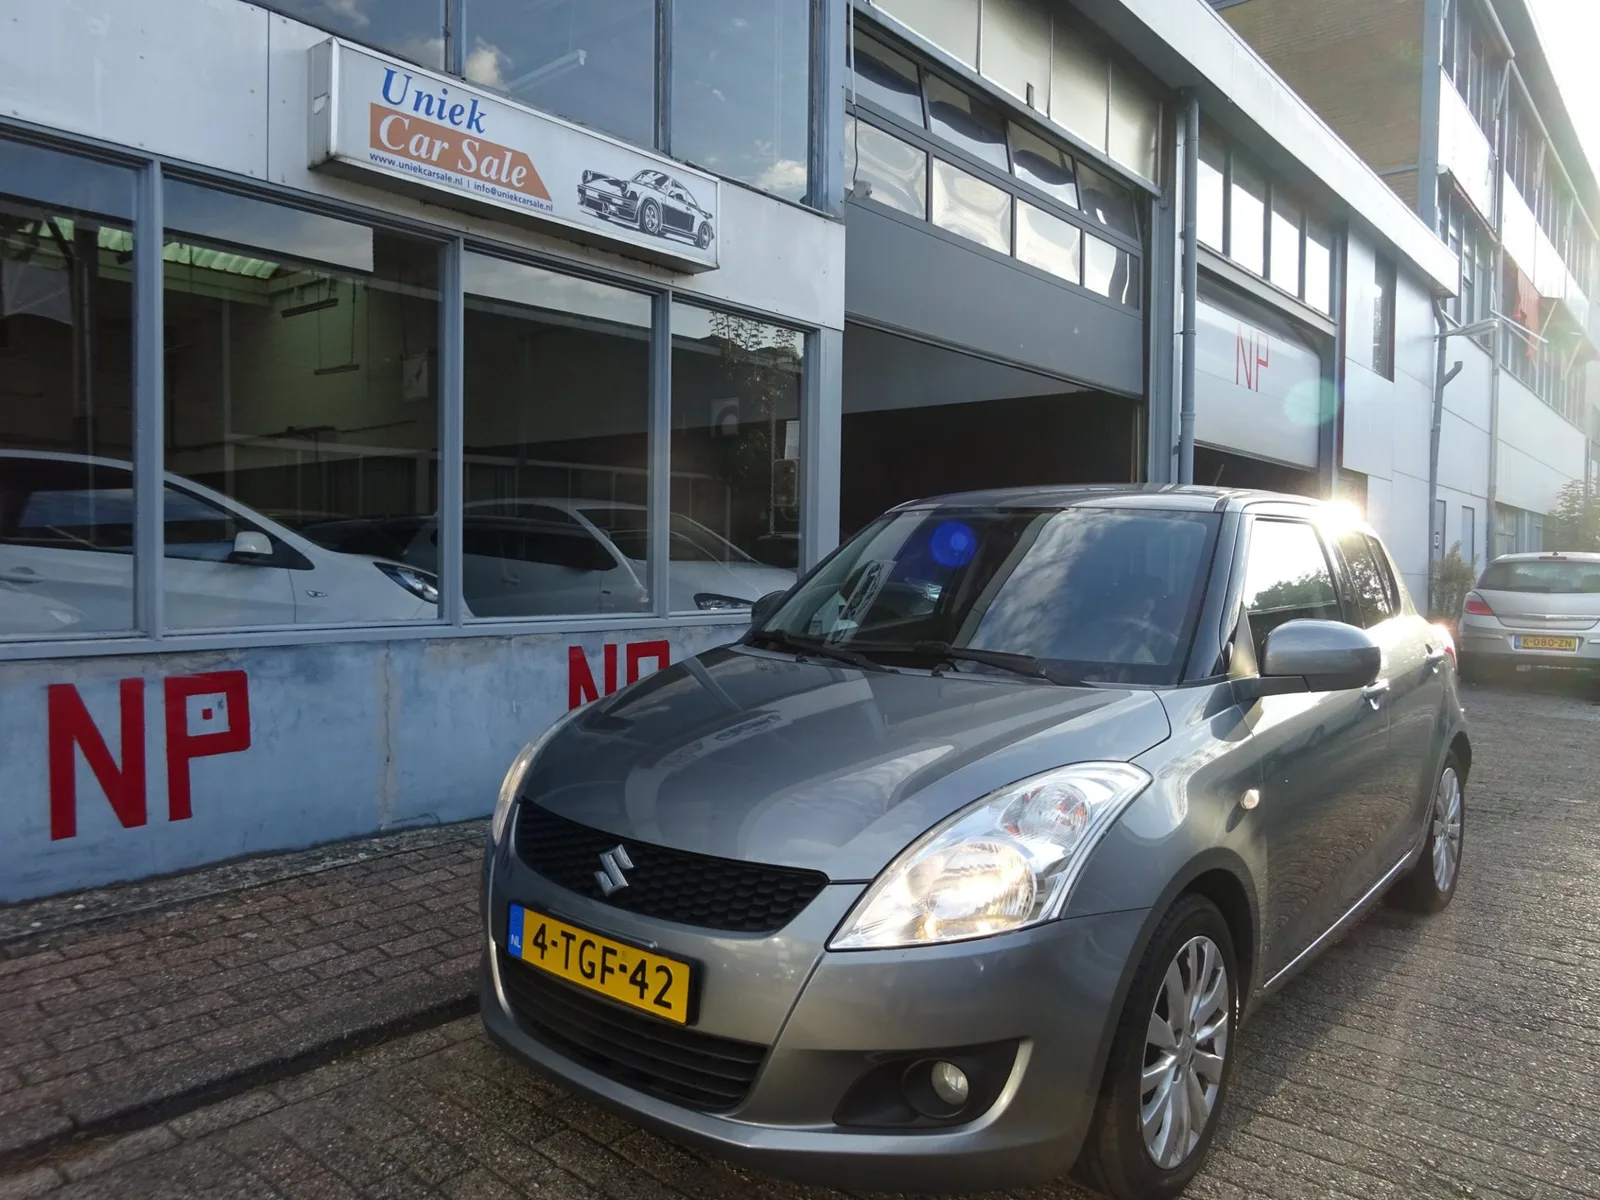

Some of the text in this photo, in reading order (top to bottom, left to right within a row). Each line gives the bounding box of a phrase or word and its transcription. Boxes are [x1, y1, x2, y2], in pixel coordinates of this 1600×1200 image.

[382, 67, 487, 134] Uniek
[369, 152, 554, 212] www.uniekcarsale.nl info@uniekcarsale.nl
[379, 114, 527, 188] Car Sale
[1236, 324, 1269, 392] NP
[48, 670, 251, 841] NP
[510, 922, 673, 1010] NL 4-TGF-42
